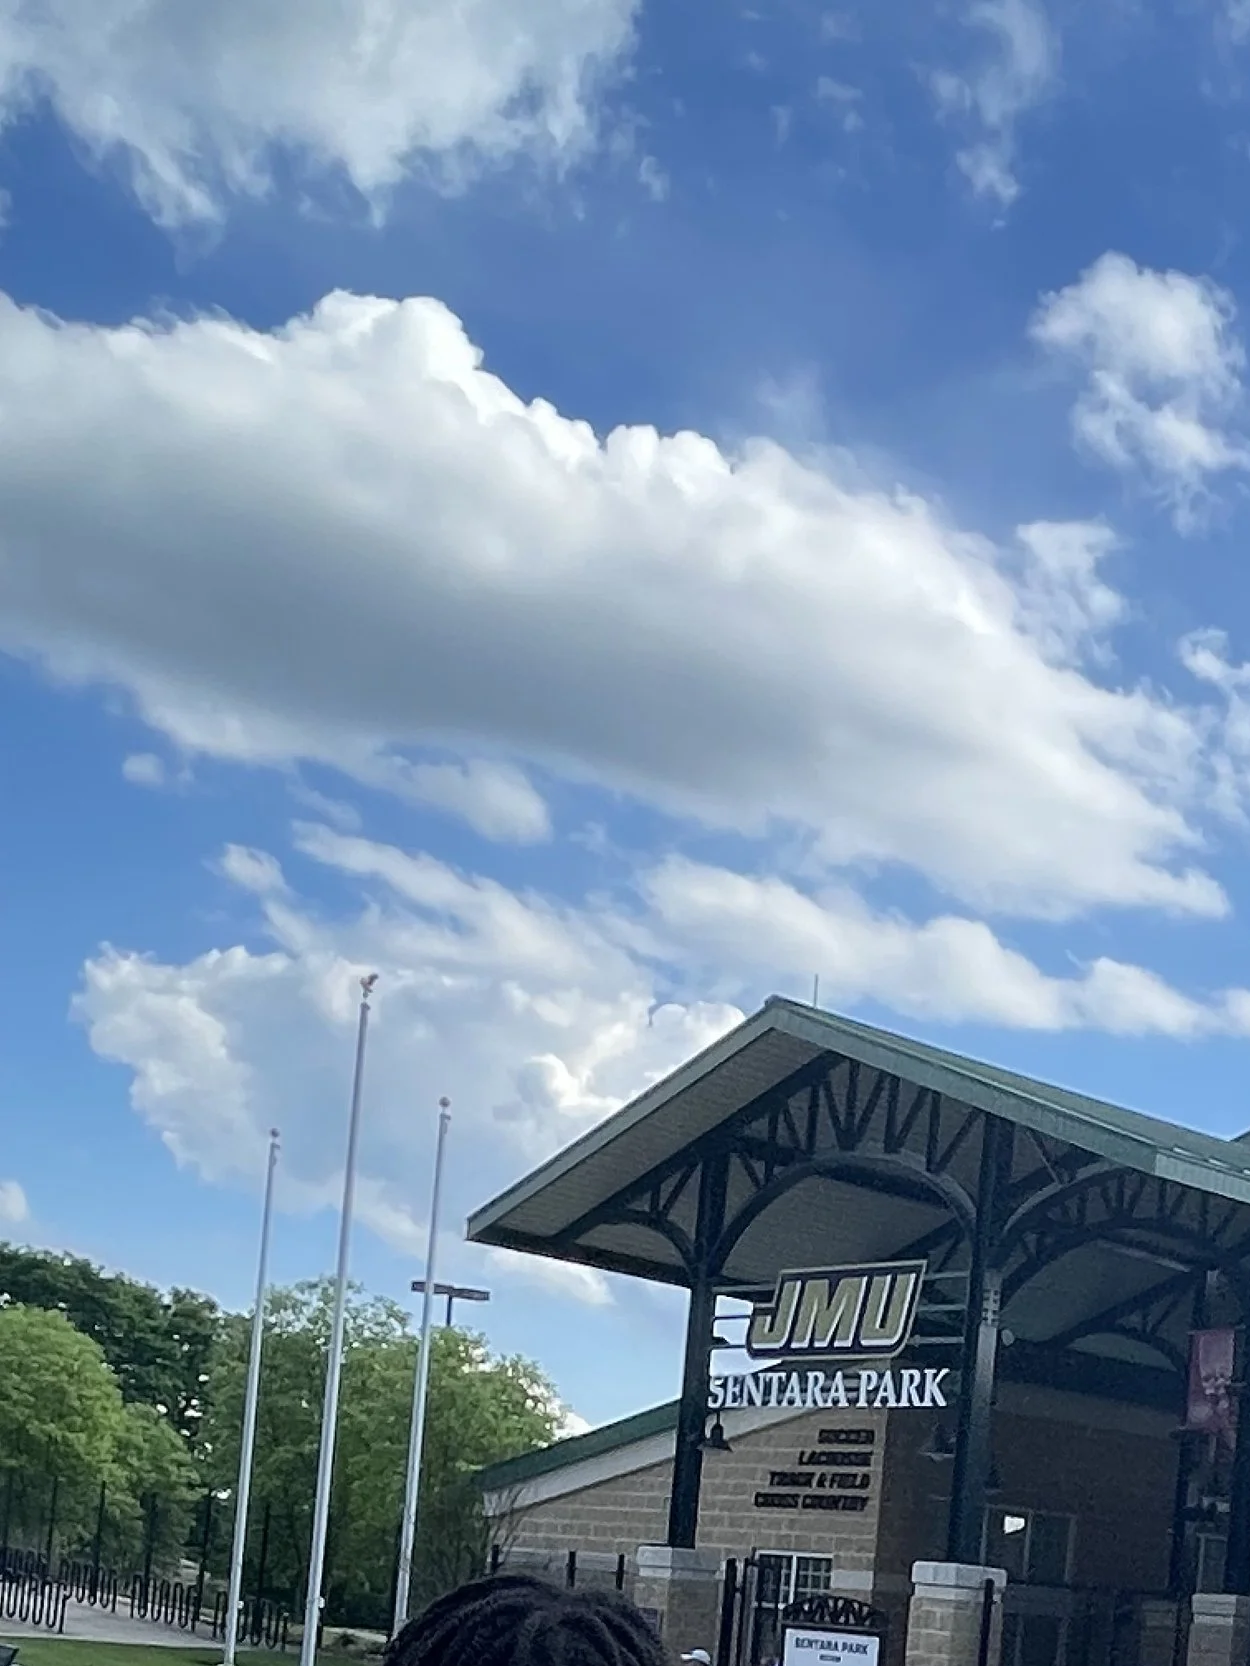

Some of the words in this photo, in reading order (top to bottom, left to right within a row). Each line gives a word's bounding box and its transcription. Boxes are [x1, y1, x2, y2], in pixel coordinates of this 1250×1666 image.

[750, 1272, 917, 1349] JMU
[707, 1369, 850, 1409] SENTARA
[855, 1367, 951, 1408] PARK
[841, 1641, 870, 1656] PARK
